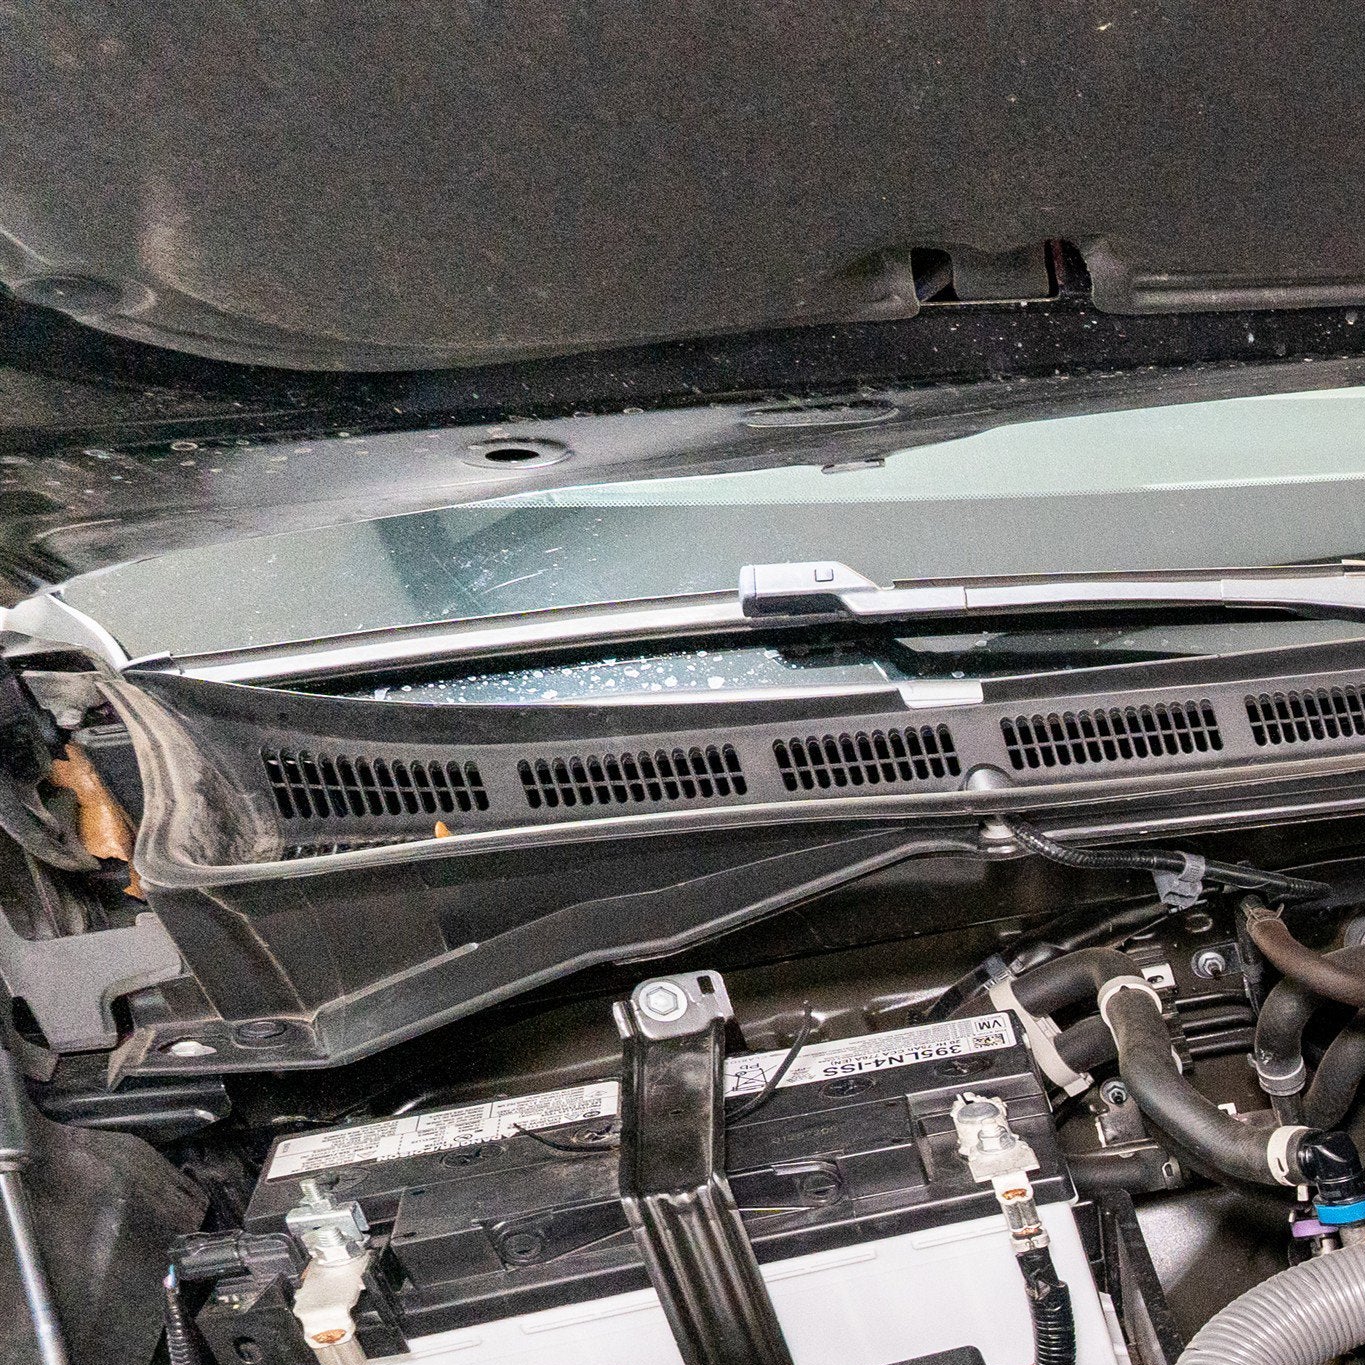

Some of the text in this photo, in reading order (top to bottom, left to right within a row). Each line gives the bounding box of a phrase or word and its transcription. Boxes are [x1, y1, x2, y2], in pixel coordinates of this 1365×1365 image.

[978, 1018, 1001, 1031] VM
[881, 1048, 905, 1057] CCA
[822, 1044, 962, 1077] 395LN4-ISS
[739, 1062, 759, 1071] Pb
